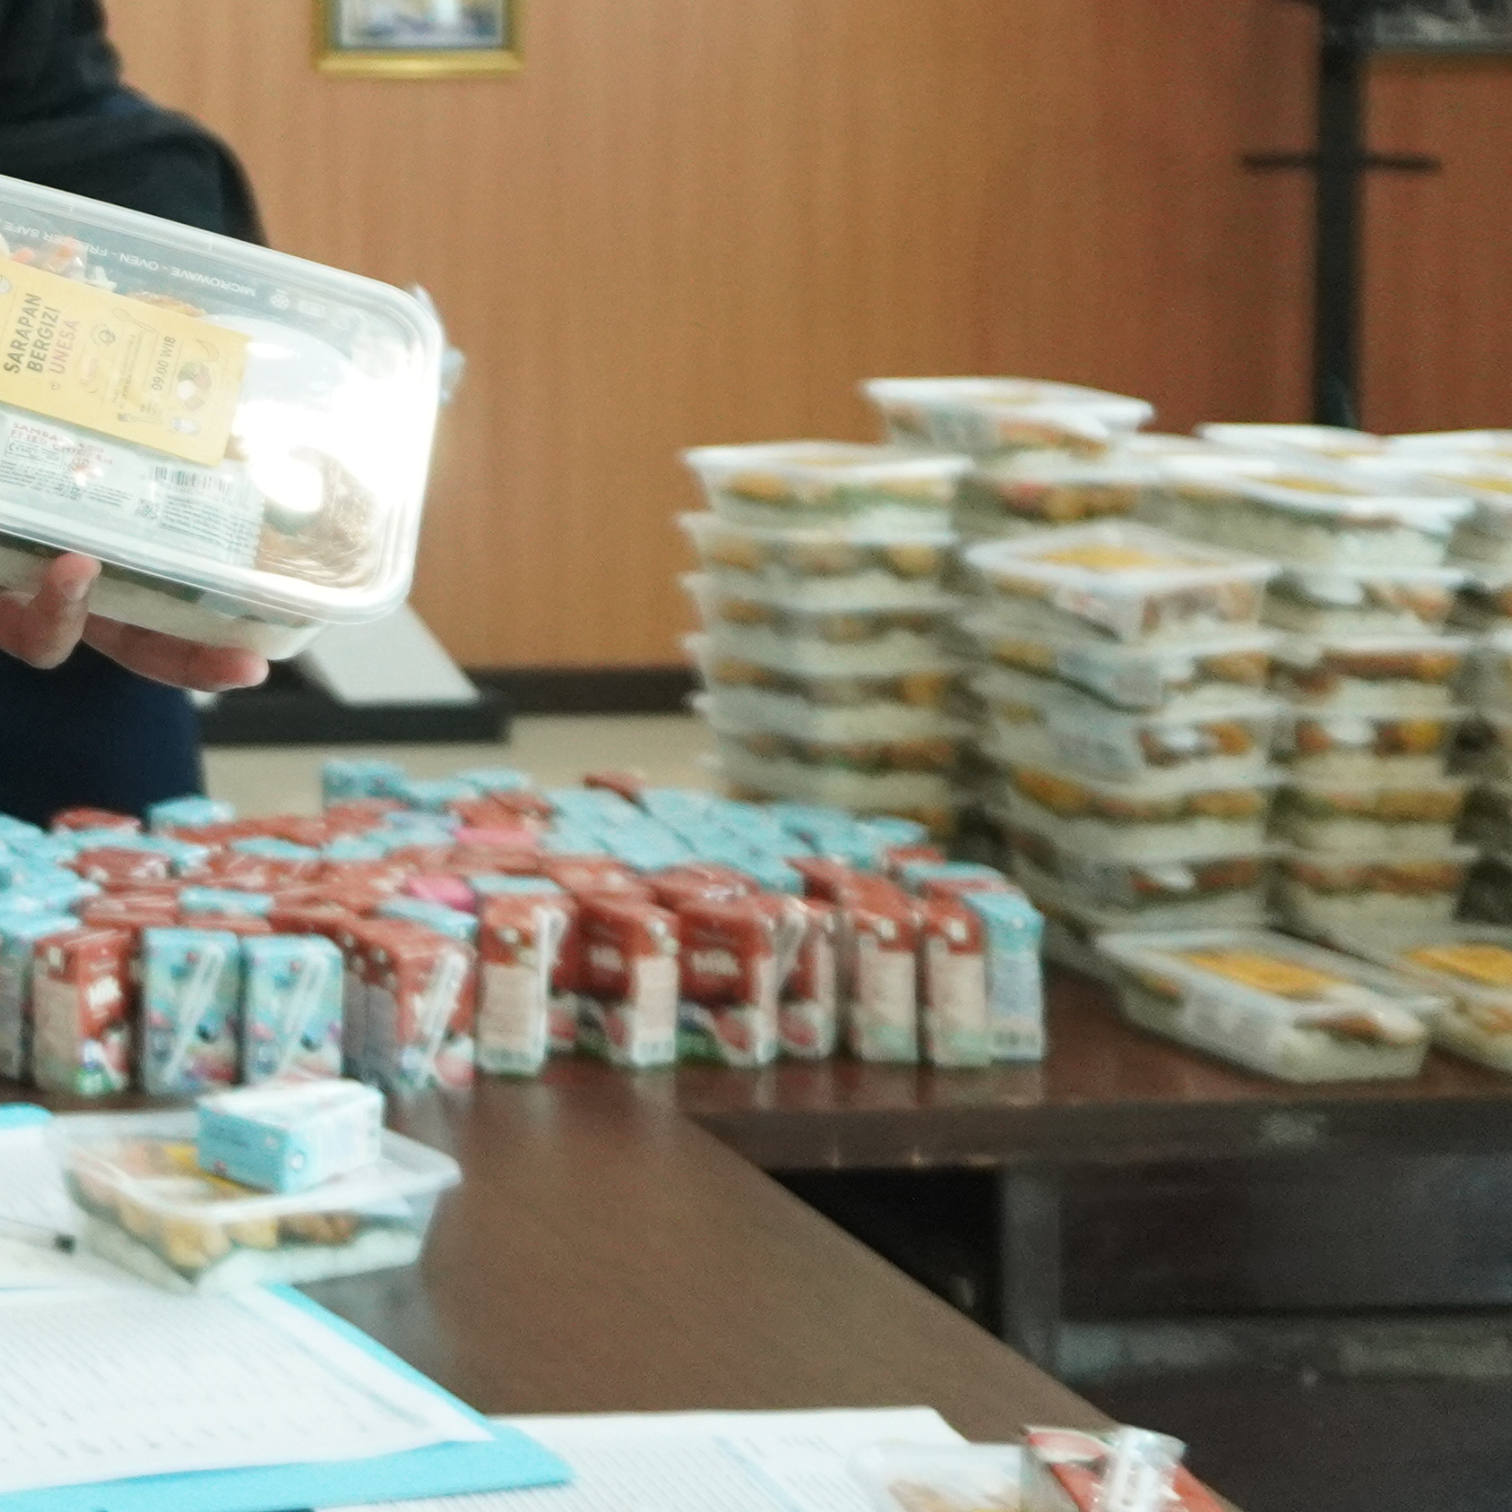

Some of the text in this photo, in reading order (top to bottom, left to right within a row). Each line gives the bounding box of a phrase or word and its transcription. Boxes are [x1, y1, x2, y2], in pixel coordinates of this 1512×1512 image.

[3, 221, 41, 240] SAFE
[118, 252, 159, 271] OVEN
[171, 266, 257, 297] MICROWAVE
[3, 293, 42, 374] SARAPAN
[26, 306, 61, 373] BERGIZI
[49, 319, 80, 374] UNESA
[159, 336, 176, 358] WIB
